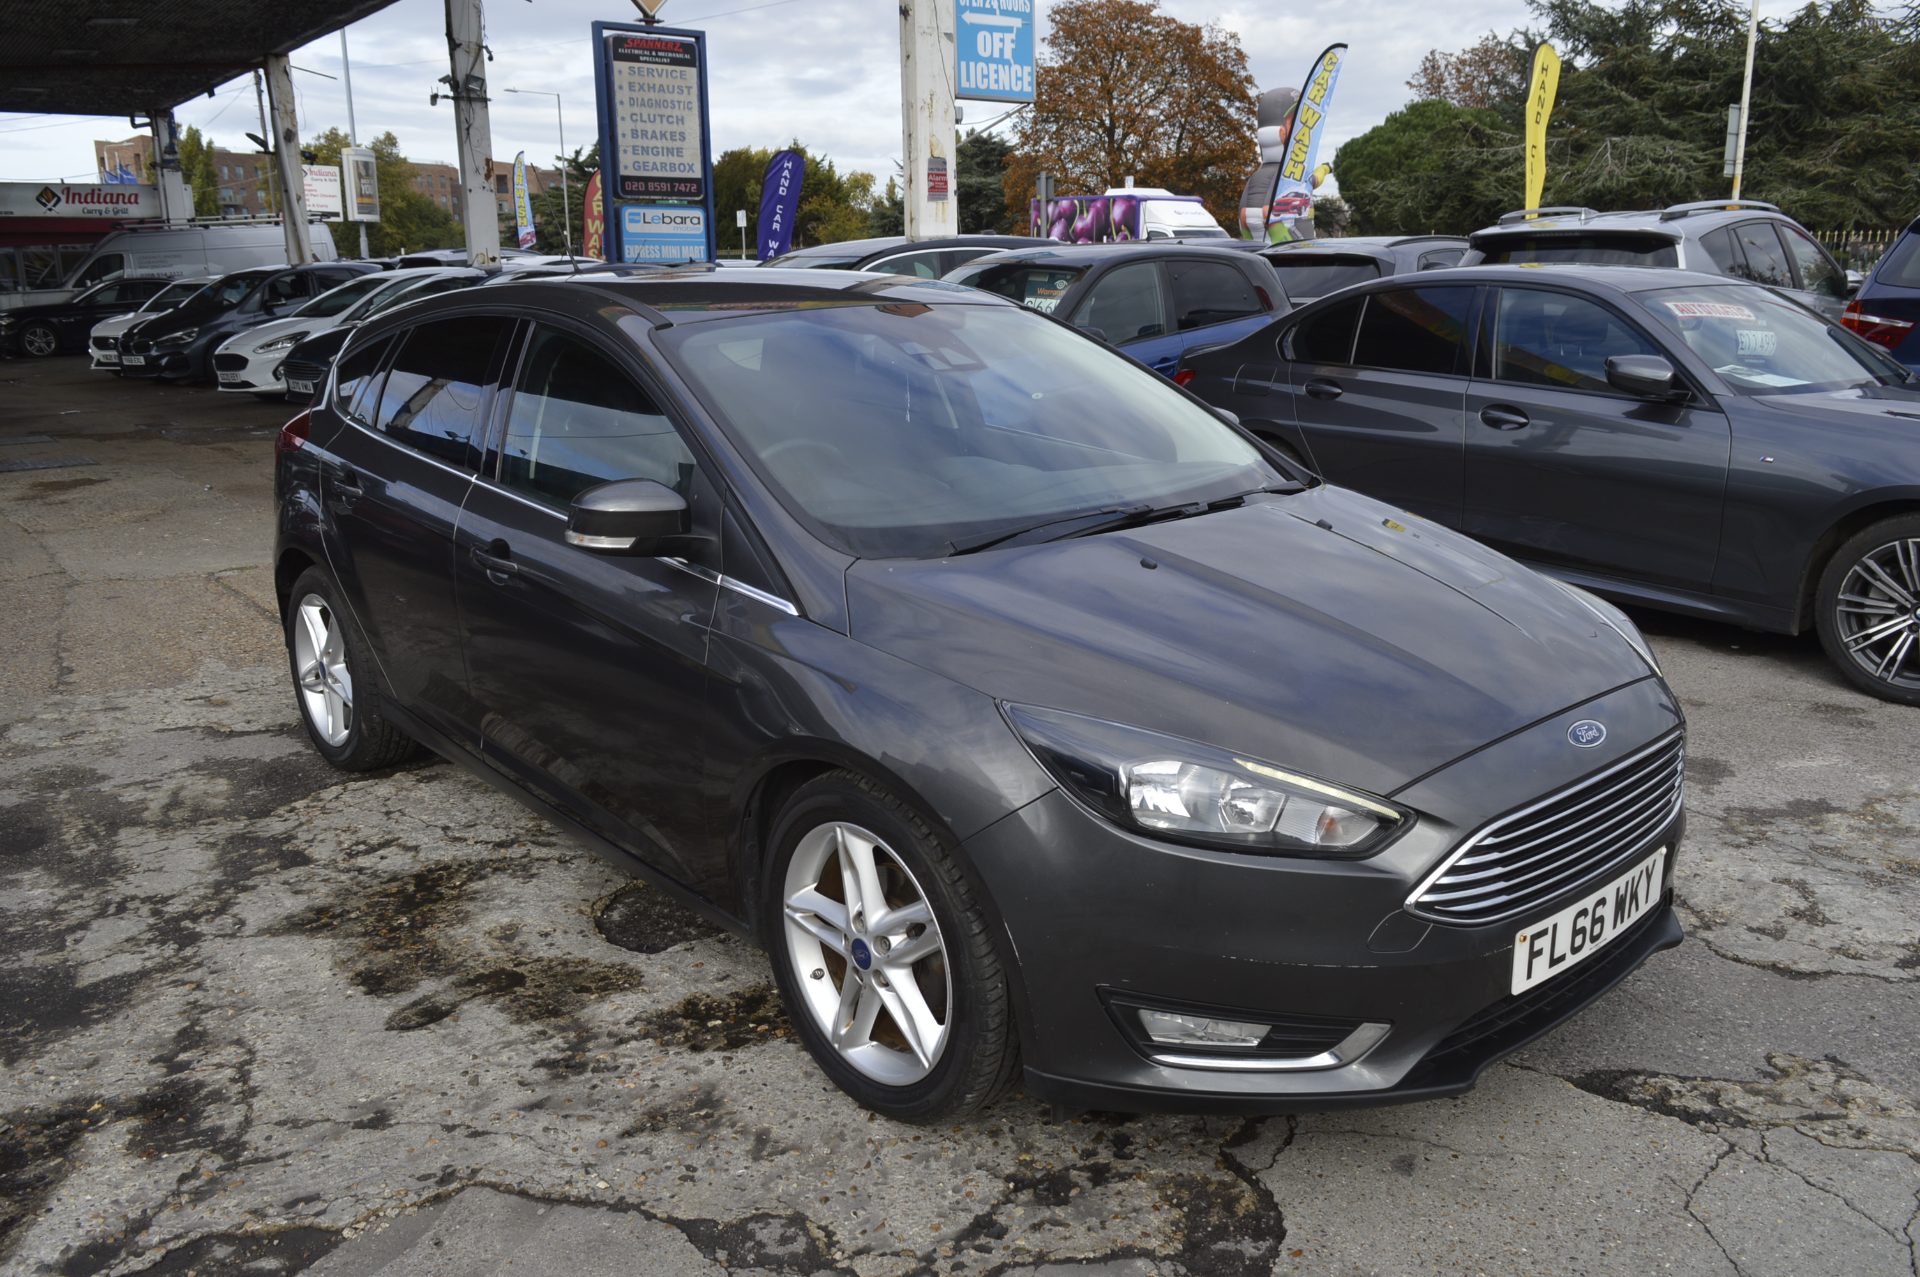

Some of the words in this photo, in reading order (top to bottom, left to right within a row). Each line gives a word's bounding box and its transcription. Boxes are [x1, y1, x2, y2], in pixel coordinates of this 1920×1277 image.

[977, 31, 1015, 60] OFF
[618, 48, 651, 56] ELECTRICAL
[657, 51, 691, 59] MECHANICAL
[627, 66, 687, 80] SERVICE
[960, 61, 1032, 92] LICENCE
[1307, 51, 1338, 106] CAR
[628, 82, 693, 96] EXHAUST
[1533, 63, 1548, 125] HAND
[628, 97, 693, 112] DIAGNOSTIC
[630, 113, 685, 126] CLUTCH
[631, 129, 686, 142] BRAKES
[1283, 103, 1322, 182] WASH
[631, 145, 685, 158] ENGINE
[632, 161, 695, 174] GEARBOX
[779, 160, 792, 196] HAND
[625, 181, 645, 191] 020
[648, 182, 671, 192] 8591
[674, 183, 697, 193] 7472
[62, 187, 140, 205] Indiana
[82, 207, 103, 216] Curry
[642, 212, 701, 225] Lebara
[773, 205, 784, 232] CAR
[625, 245, 660, 258] EXPRESS
[662, 246, 680, 259] MINI
[681, 246, 705, 259] MART
[1675, 304, 1750, 317] AUTOMATIC
[1576, 726, 1599, 743] Ford
[1527, 897, 1607, 980] FL66
[1612, 858, 1656, 930] WKY
